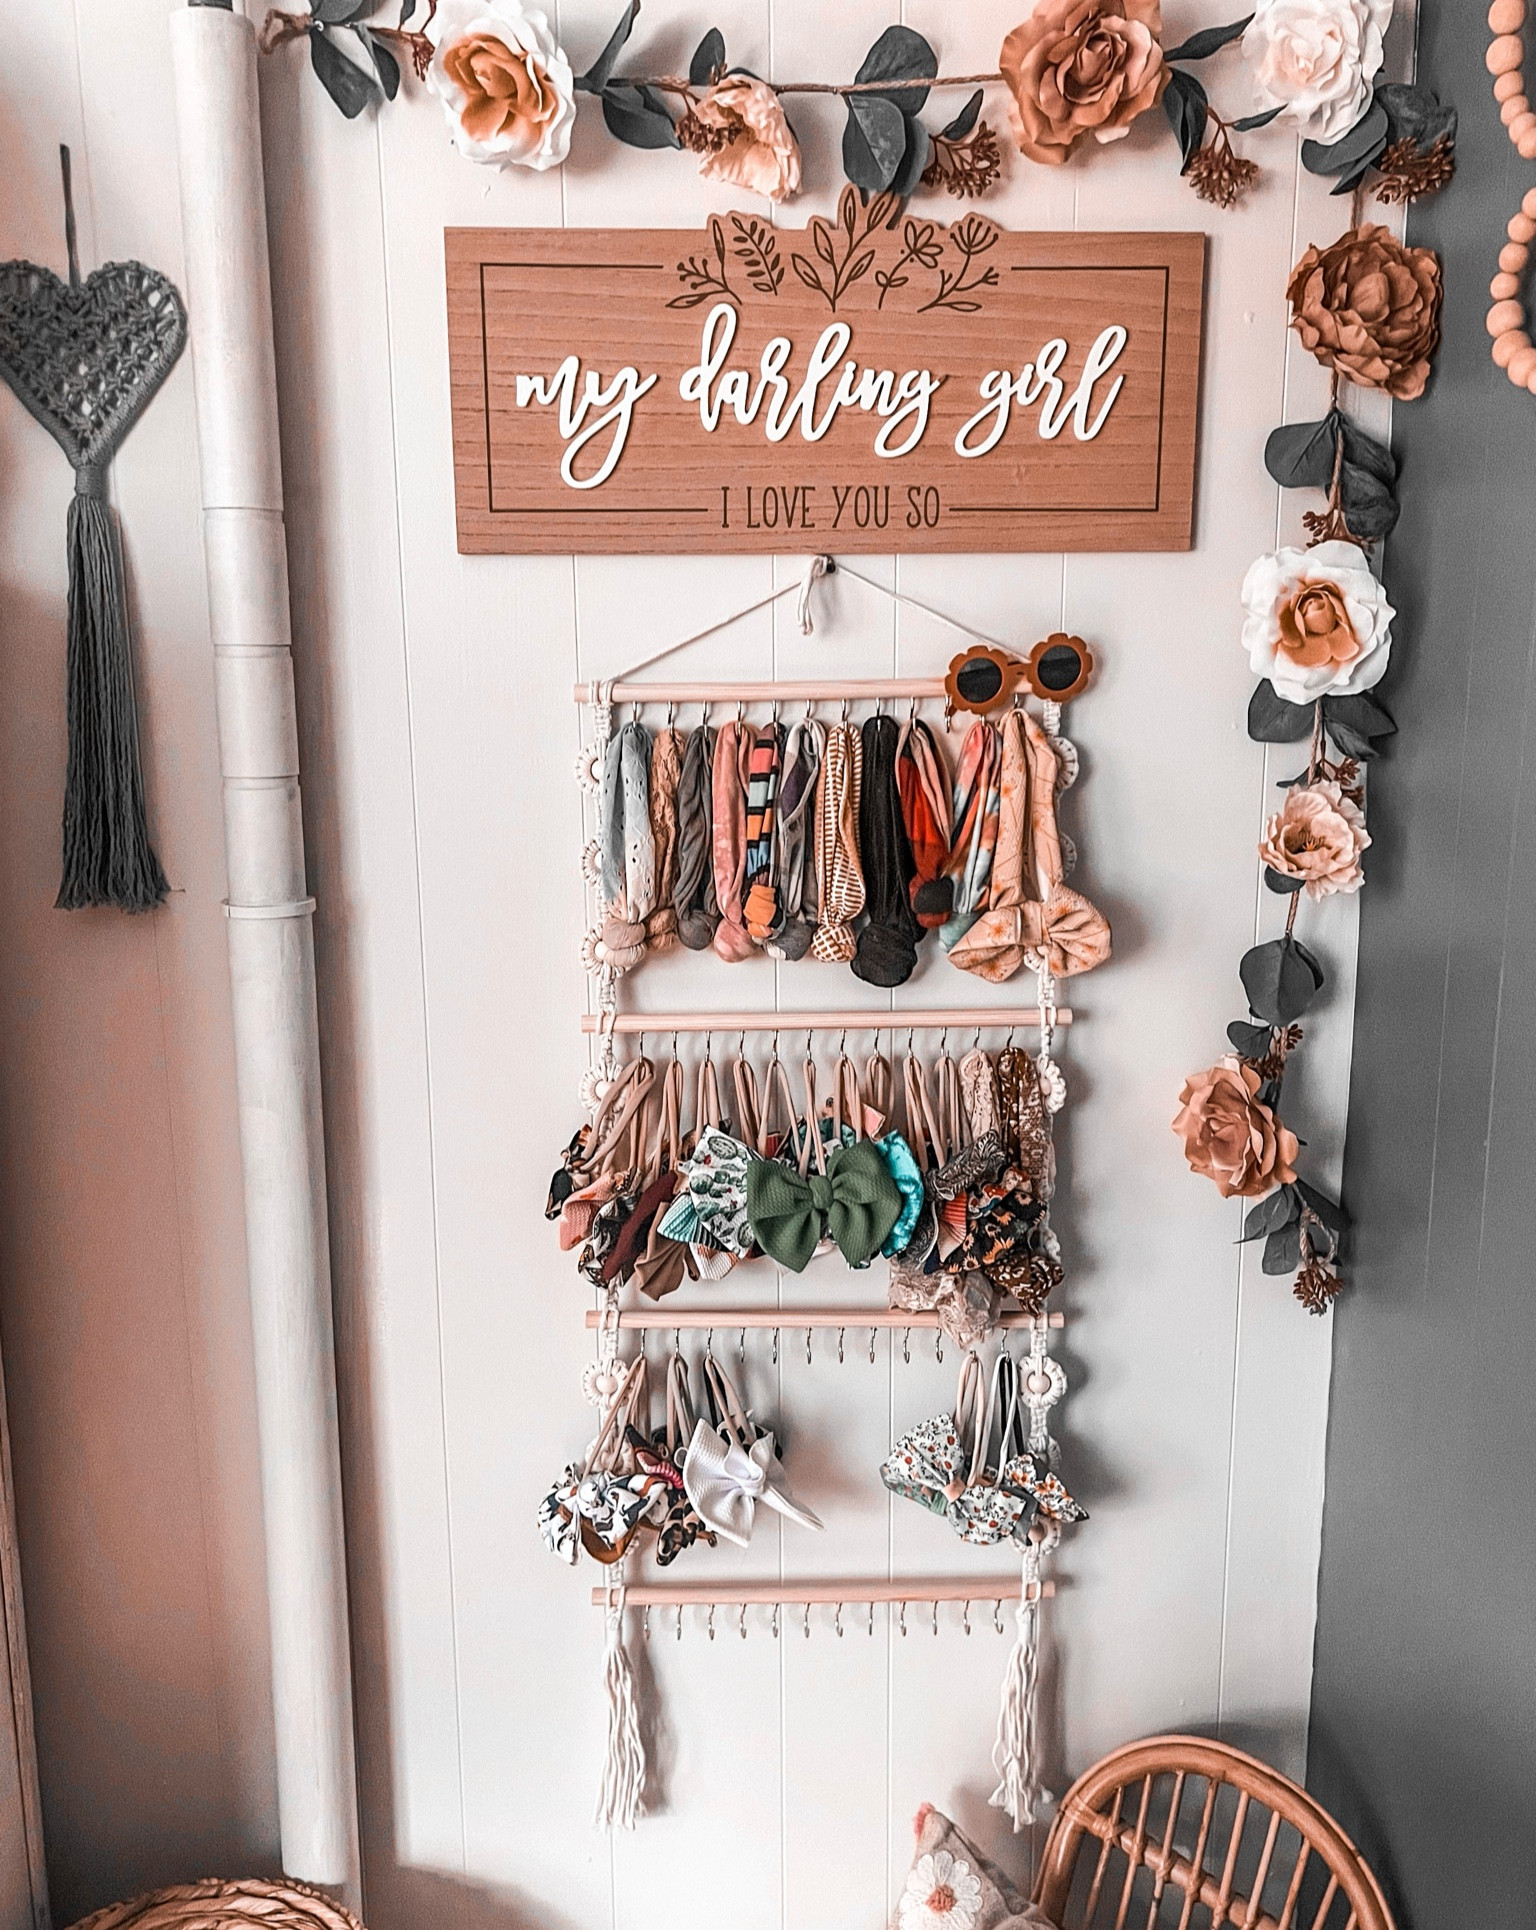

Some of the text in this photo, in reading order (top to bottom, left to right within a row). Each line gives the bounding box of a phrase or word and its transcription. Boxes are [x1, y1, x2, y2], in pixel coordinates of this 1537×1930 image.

[515, 302, 1128, 490] my darling girl
[720, 484, 941, 530] I LOVE YOU SO
